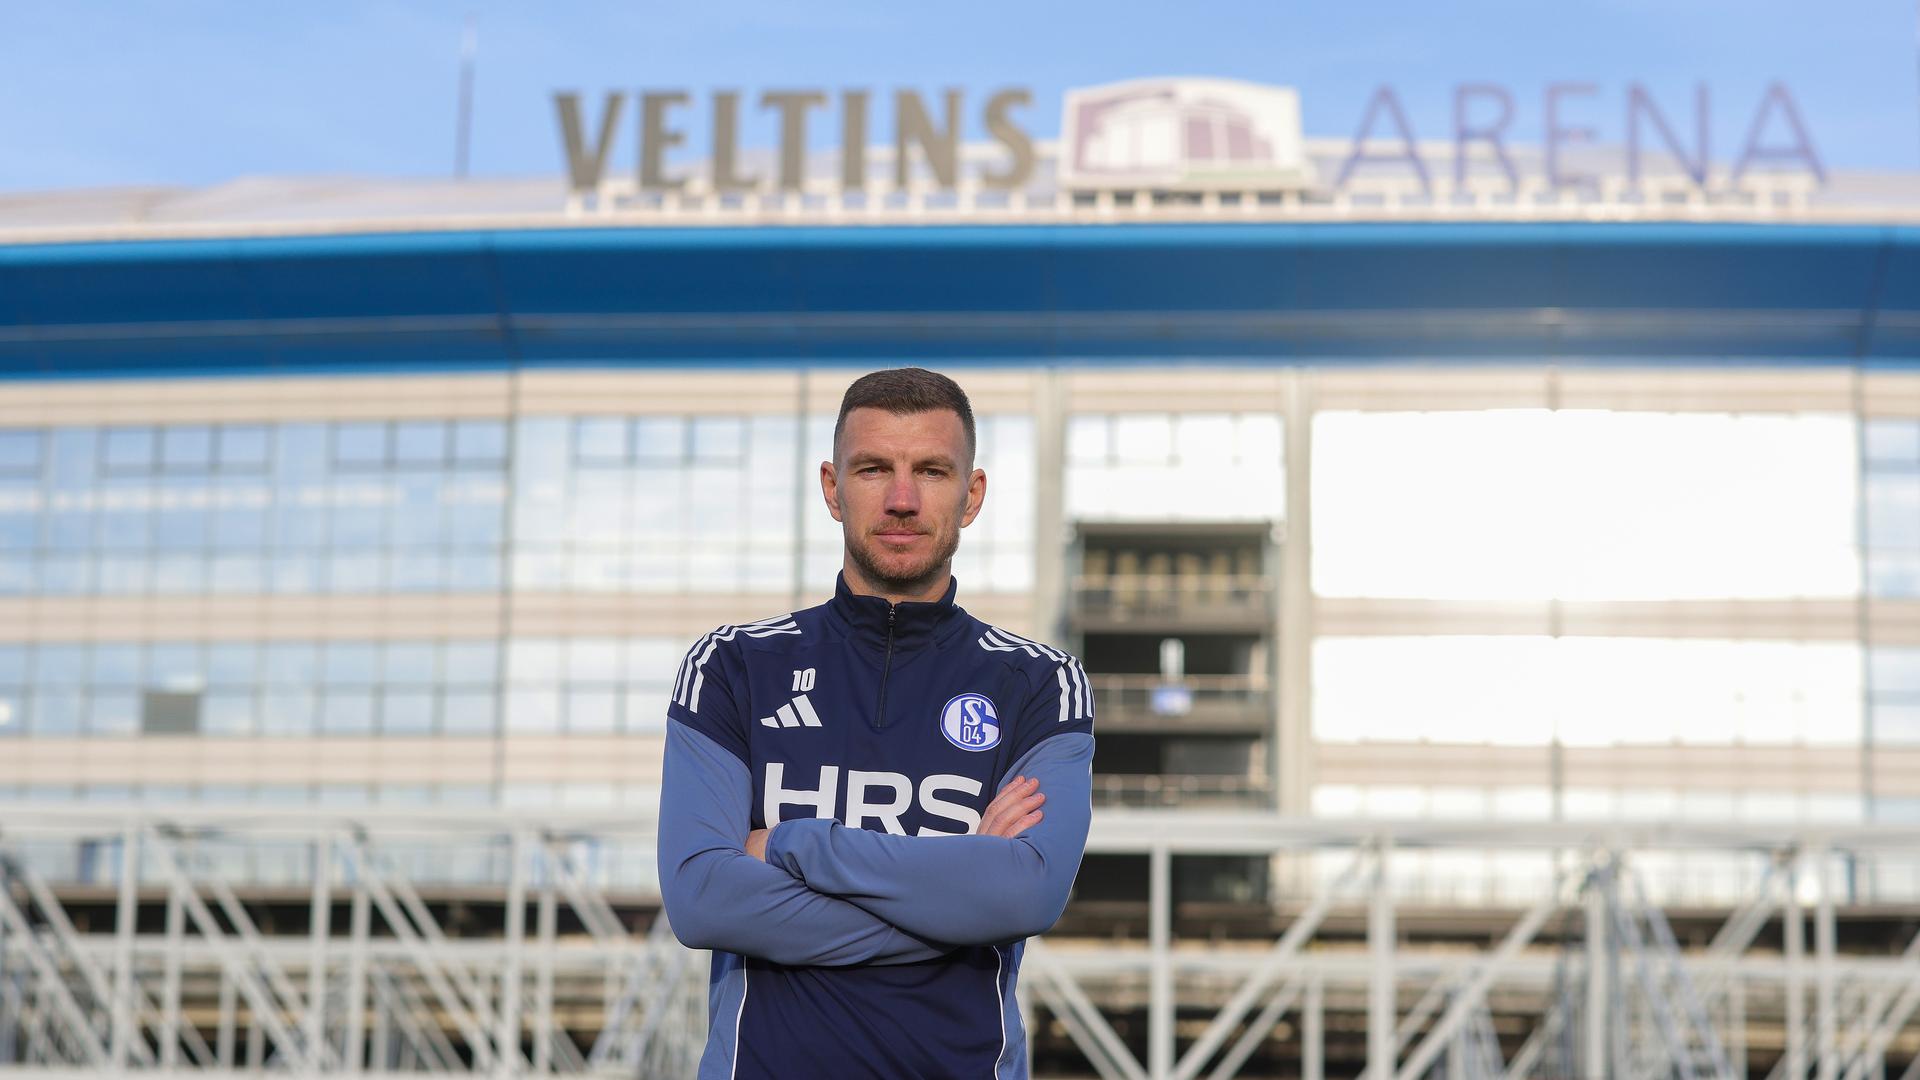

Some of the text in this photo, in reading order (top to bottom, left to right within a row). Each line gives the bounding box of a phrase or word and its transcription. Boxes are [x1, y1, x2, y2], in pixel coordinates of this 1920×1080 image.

[553, 82, 1826, 190] VELTINS ARENA
[791, 667, 816, 692] 10
[963, 725, 982, 744] 04
[763, 762, 983, 837] HRS
